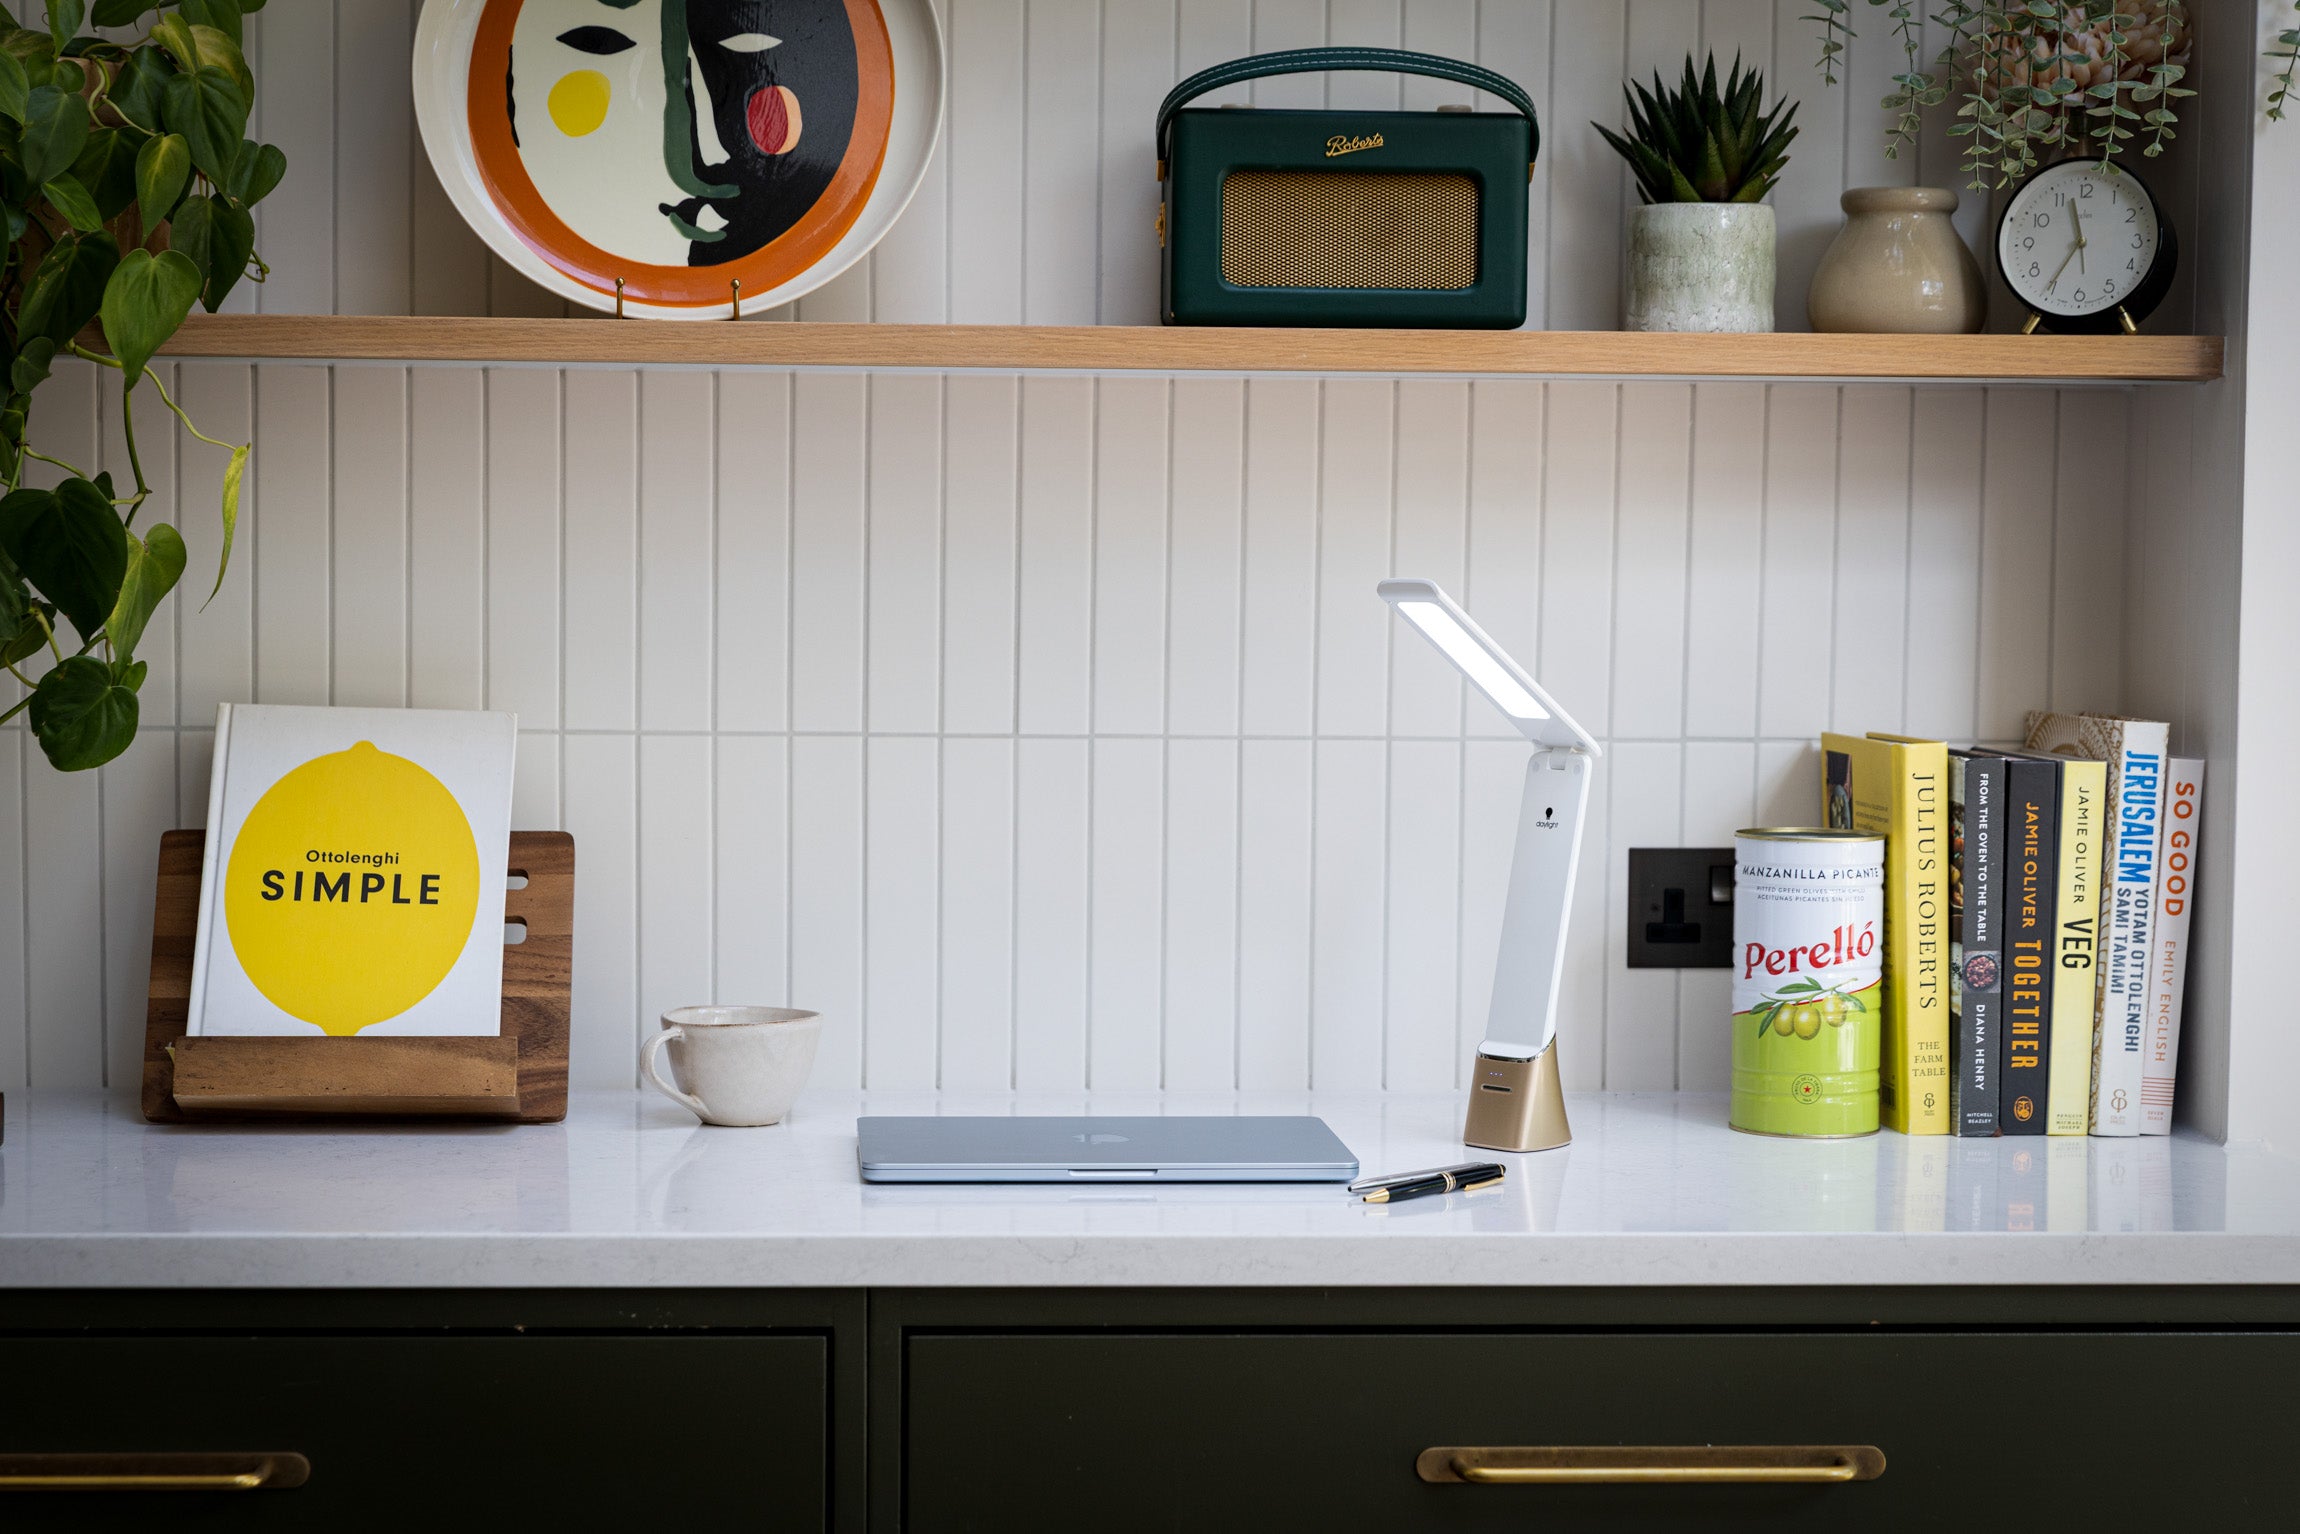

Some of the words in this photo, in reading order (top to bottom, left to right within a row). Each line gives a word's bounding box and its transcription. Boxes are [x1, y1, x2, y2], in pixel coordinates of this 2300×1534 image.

[1325, 132, 1384, 157] Roberts
[2054, 192, 2065, 207] 11
[2079, 183, 2094, 199] 12
[2112, 190, 2117, 205] 1
[2033, 213, 2050, 228] 10
[2125, 208, 2136, 223] 2
[2022, 236, 2035, 251] 9
[2131, 233, 2143, 249] 3
[2028, 261, 2040, 277] 8
[2126, 257, 2135, 271] 4
[2049, 280, 2057, 295] 7
[2073, 287, 2086, 302] 6
[2103, 278, 2115, 294] 5
[1979, 773, 1989, 805] FROM
[2173, 781, 2195, 819] SO
[1912, 773, 1936, 871] JULIUS
[1978, 807, 1988, 830] THE
[2076, 786, 2089, 837] JAMIE
[2118, 750, 2159, 883] JERUSALEM
[2023, 802, 2040, 857] JAMIE
[306, 850, 400, 867] Ottolenghi
[1978, 832, 1988, 863] OVEN
[260, 870, 440, 905] SIMPLE
[1742, 865, 1826, 879] MANZANILLA
[1832, 867, 1880, 879] PICANTE
[1977, 864, 1987, 882] TO
[2073, 842, 2087, 904] OLIVER
[2165, 830, 2190, 916] GOOD
[1977, 883, 1987, 906] THE
[2021, 861, 2038, 929] OLIVER
[2114, 887, 2131, 928] SAMI
[1976, 908, 1987, 942] TABLE
[2132, 888, 2149, 944] YOTAM
[1744, 920, 1875, 979] Perelló
[1918, 881, 1938, 1009] ROBERTS
[2061, 918, 2094, 969] VEG
[2110, 934, 2128, 994] TAMIMI
[2162, 940, 2176, 986] EMILY
[2011, 939, 2042, 1068] TOGETHER
[2124, 950, 2145, 1052] OTTOLENGHI
[1975, 1004, 1986, 1044] DIANA
[2155, 993, 2171, 1062] ENGLISH
[1914, 1054, 1944, 1064] FARM
[1917, 1041, 1941, 1050] THE
[1911, 1067, 1946, 1077] TABLE
[1974, 1049, 1985, 1090] HENRY
